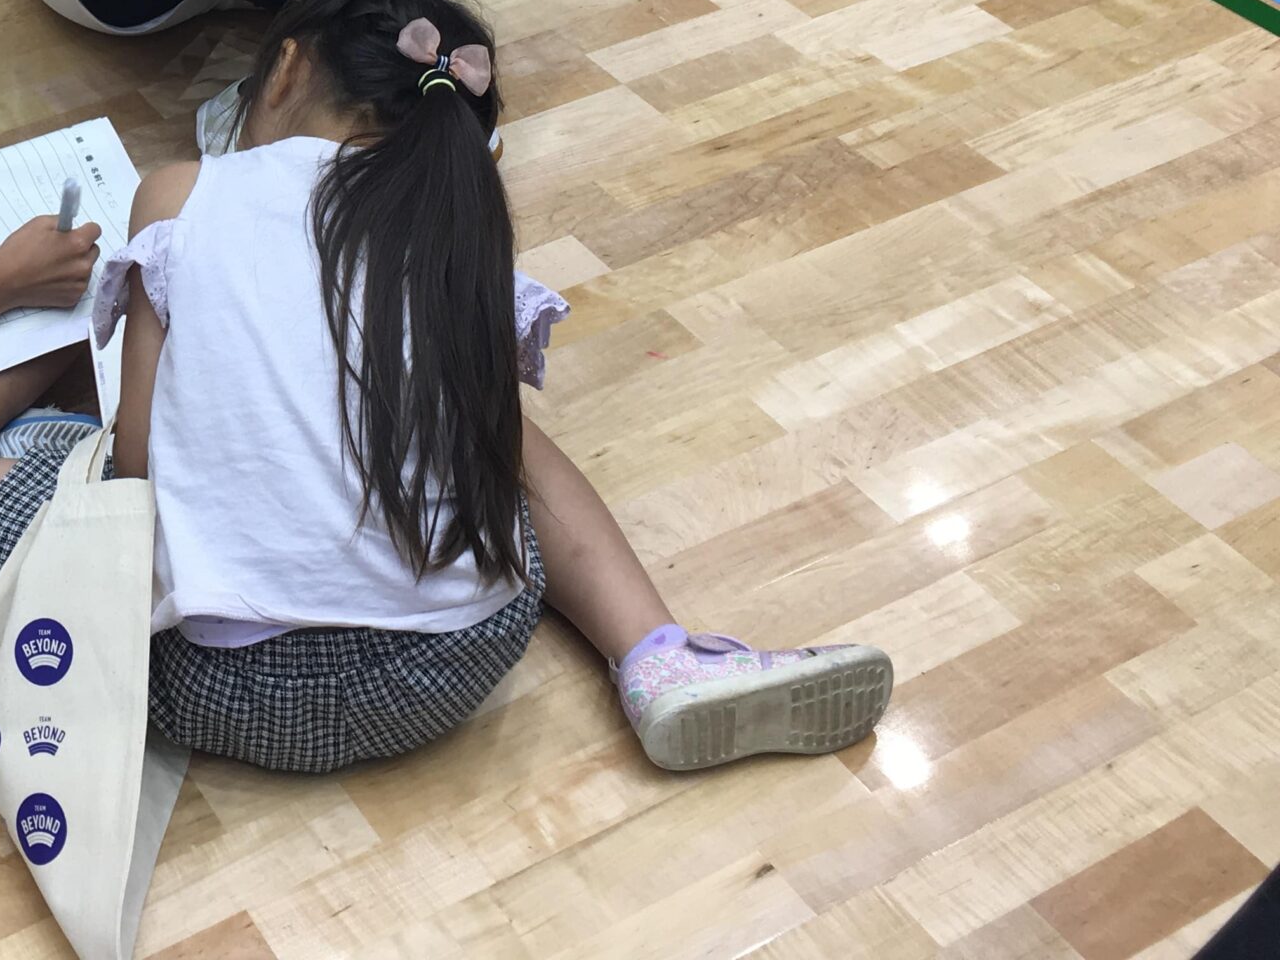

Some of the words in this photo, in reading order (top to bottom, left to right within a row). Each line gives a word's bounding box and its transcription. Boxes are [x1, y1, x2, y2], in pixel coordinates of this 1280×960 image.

[22, 638, 67, 657] BEYOND
[23, 725, 66, 744] BEYOND
[21, 814, 60, 834] BEYOND
